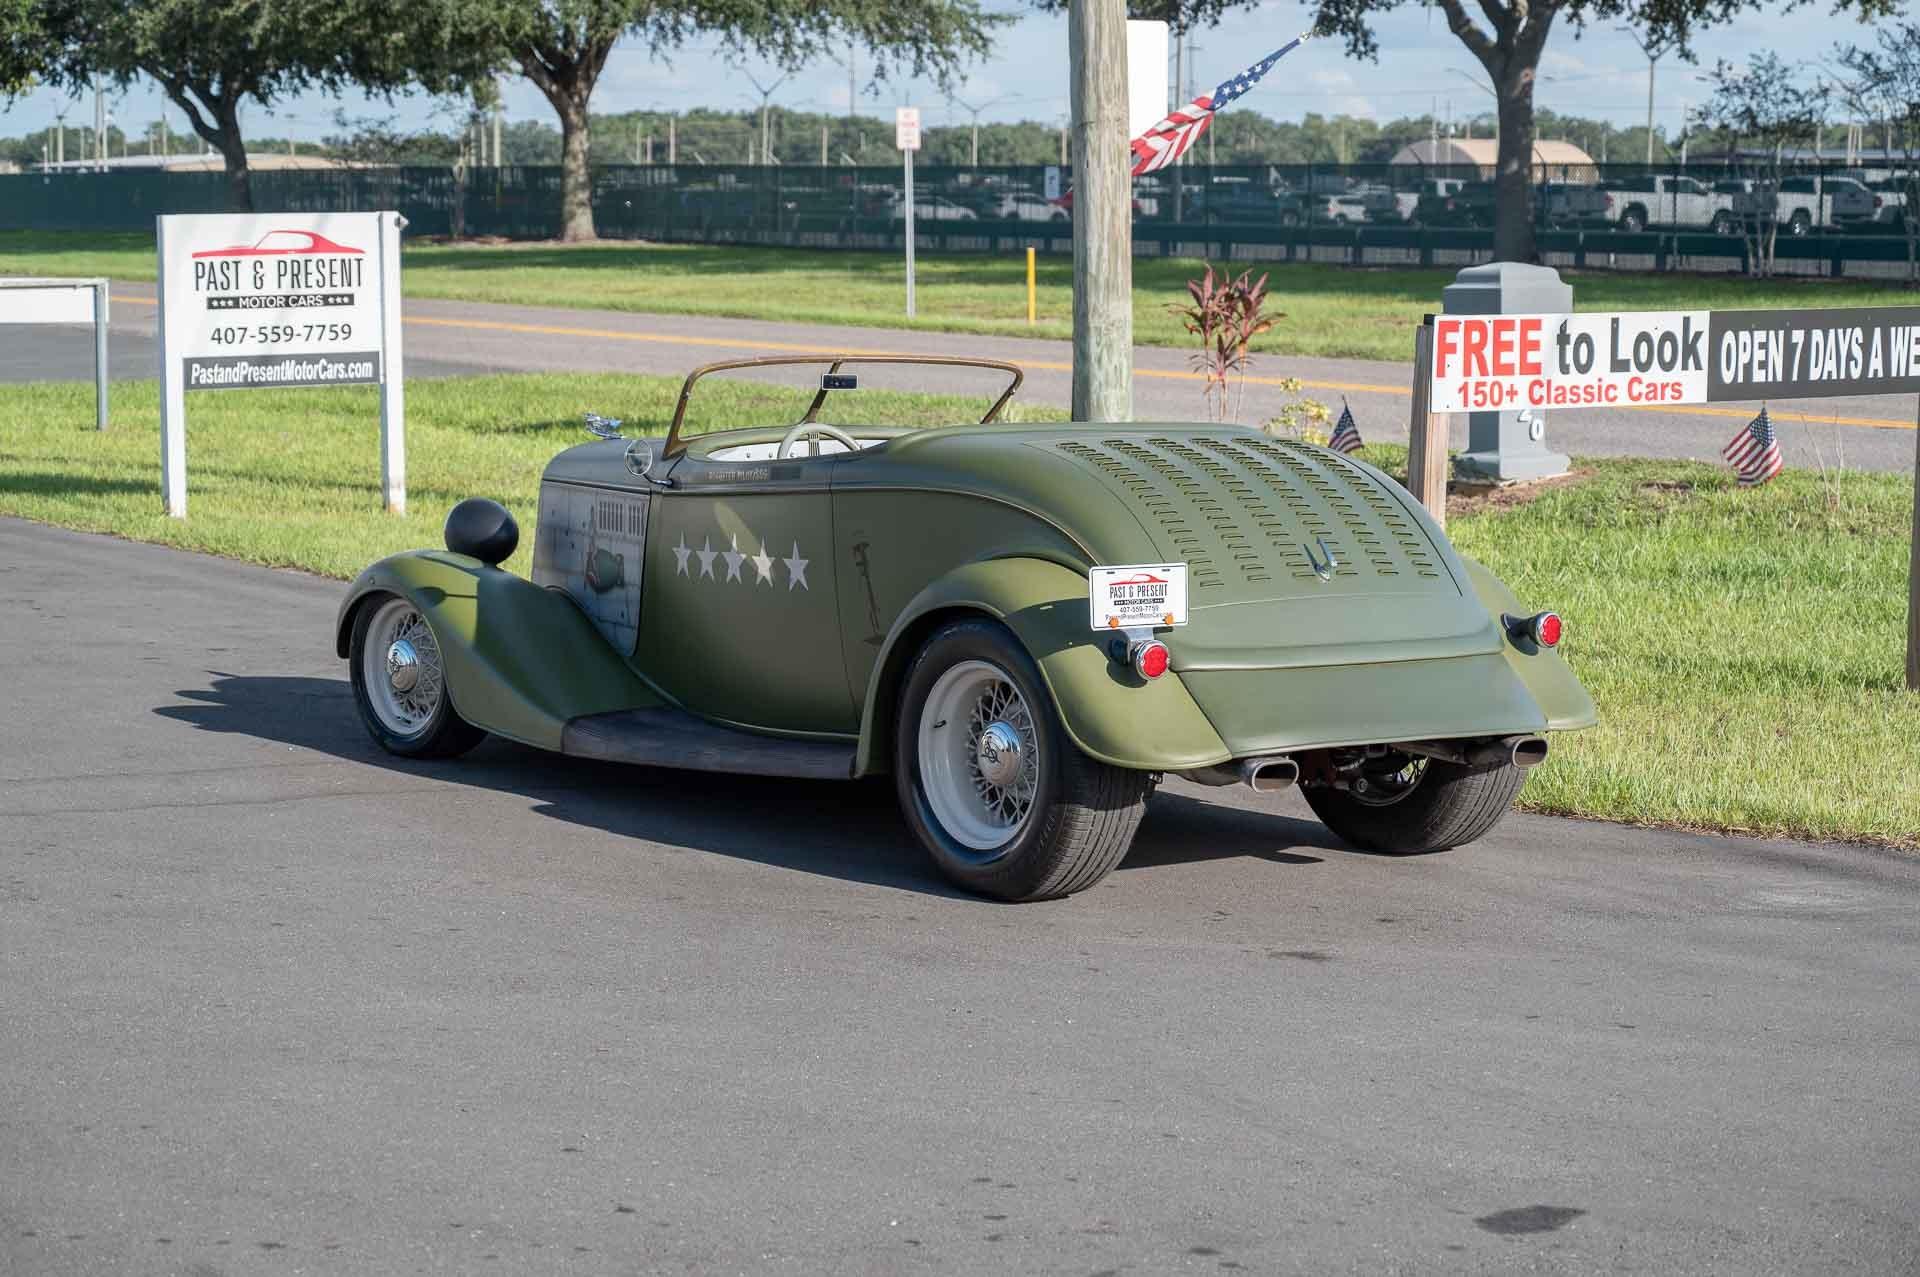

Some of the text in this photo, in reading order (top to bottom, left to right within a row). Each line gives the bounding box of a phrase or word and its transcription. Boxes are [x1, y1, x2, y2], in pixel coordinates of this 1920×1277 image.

[194, 258, 364, 291] PAST & PRESENT
[239, 295, 324, 309] MOTOR CARS
[210, 323, 353, 345] 407-559-7759
[1436, 316, 1704, 378] FREE to Look
[1720, 329, 1784, 384] OPEN
[1791, 329, 1805, 381] 7
[1809, 326, 1864, 381] DAYS
[1867, 327, 1884, 378] A
[190, 358, 373, 385] PastandPresentMotorCars.com
[1457, 376, 1683, 408] 150+ Classic Cars
[1109, 586, 1126, 599] PAST
[1137, 584, 1168, 597] PRESENT
